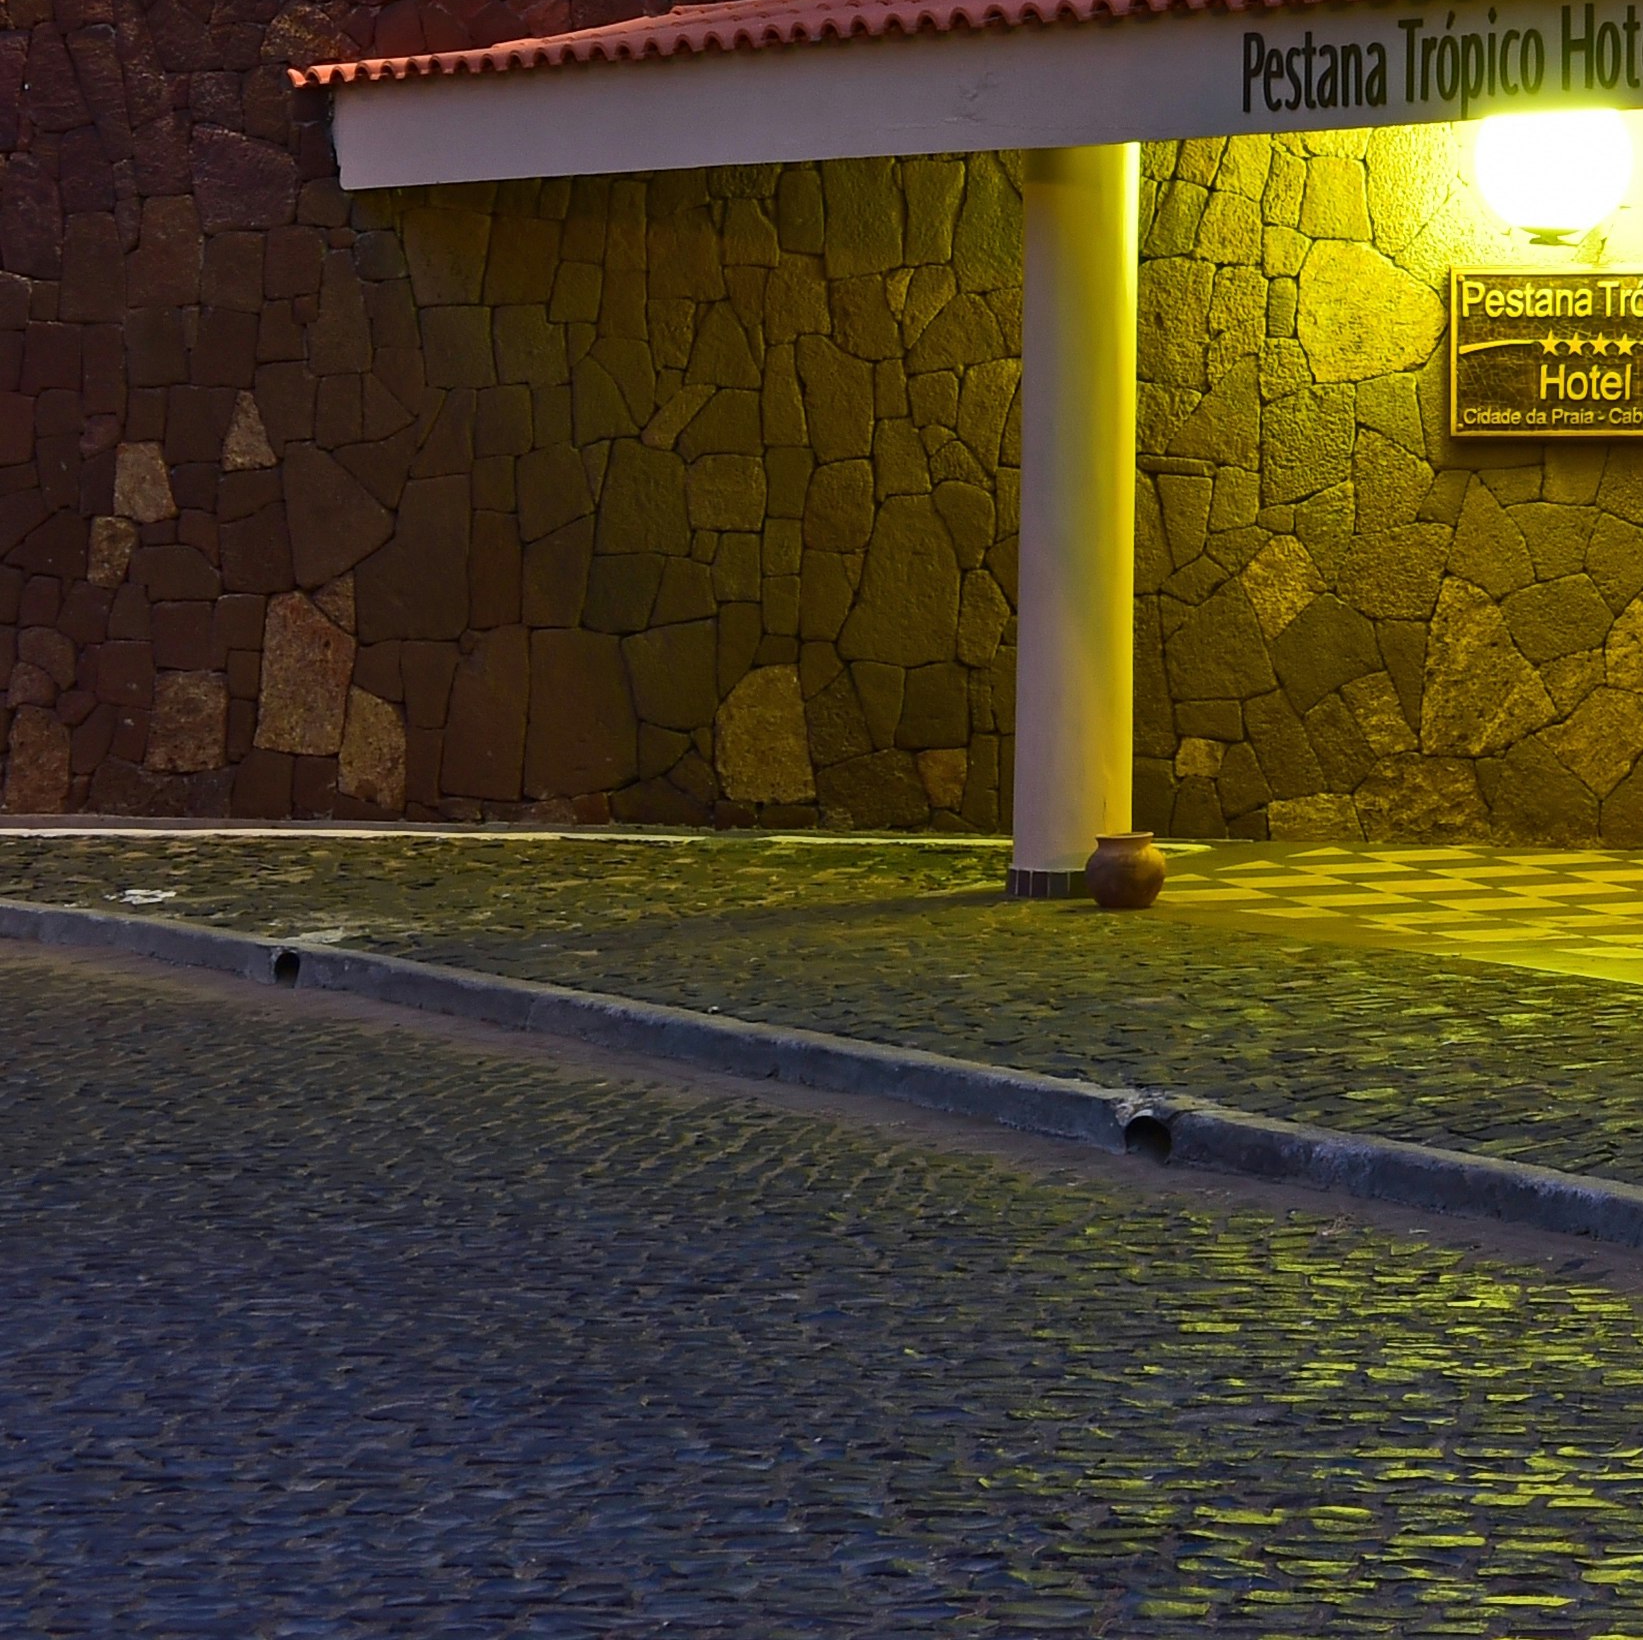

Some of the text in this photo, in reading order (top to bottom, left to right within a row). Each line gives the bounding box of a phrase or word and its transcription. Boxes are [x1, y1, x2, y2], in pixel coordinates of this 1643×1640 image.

[1242, 31, 1387, 113] Pestana
[1397, 7, 1545, 119] Trópico
[1461, 280, 1593, 317] Pestana
[1539, 363, 1632, 401] Hotel
[1463, 408, 1521, 426] Cidade
[1526, 408, 1547, 425] da
[1551, 408, 1594, 425] Praia
